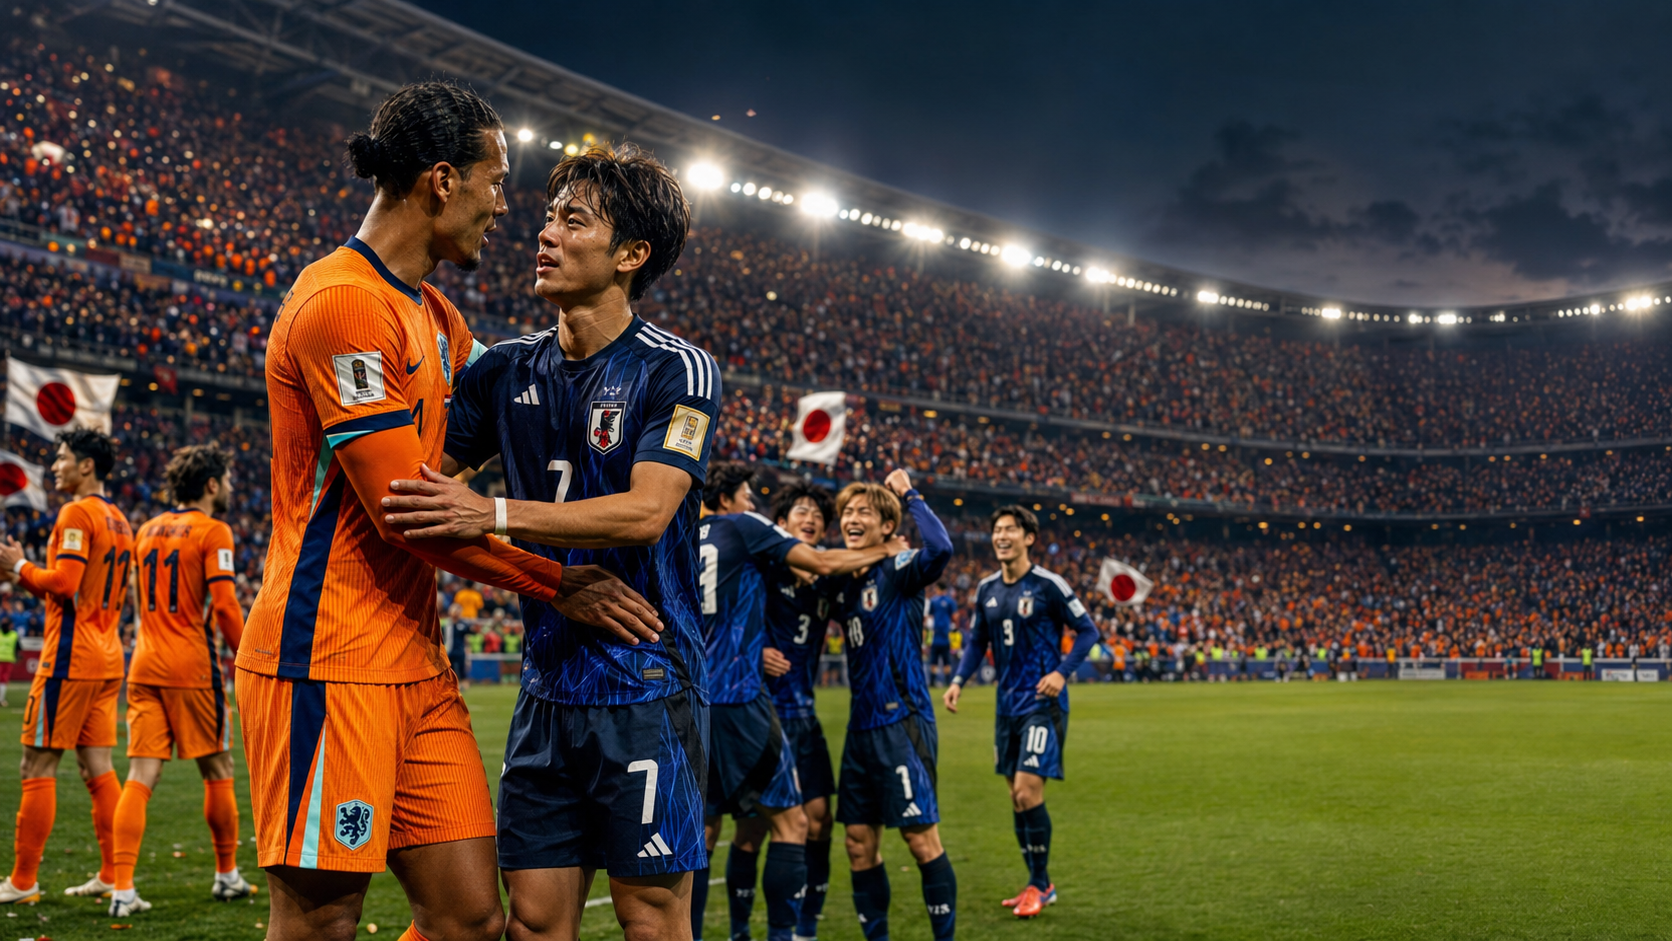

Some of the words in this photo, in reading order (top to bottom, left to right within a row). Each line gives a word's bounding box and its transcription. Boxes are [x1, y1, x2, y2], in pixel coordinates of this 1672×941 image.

[547, 460, 573, 503] 7
[143, 548, 180, 613] 11
[793, 614, 811, 645] 3
[1026, 725, 1048, 754] 10
[627, 759, 658, 824] 7
